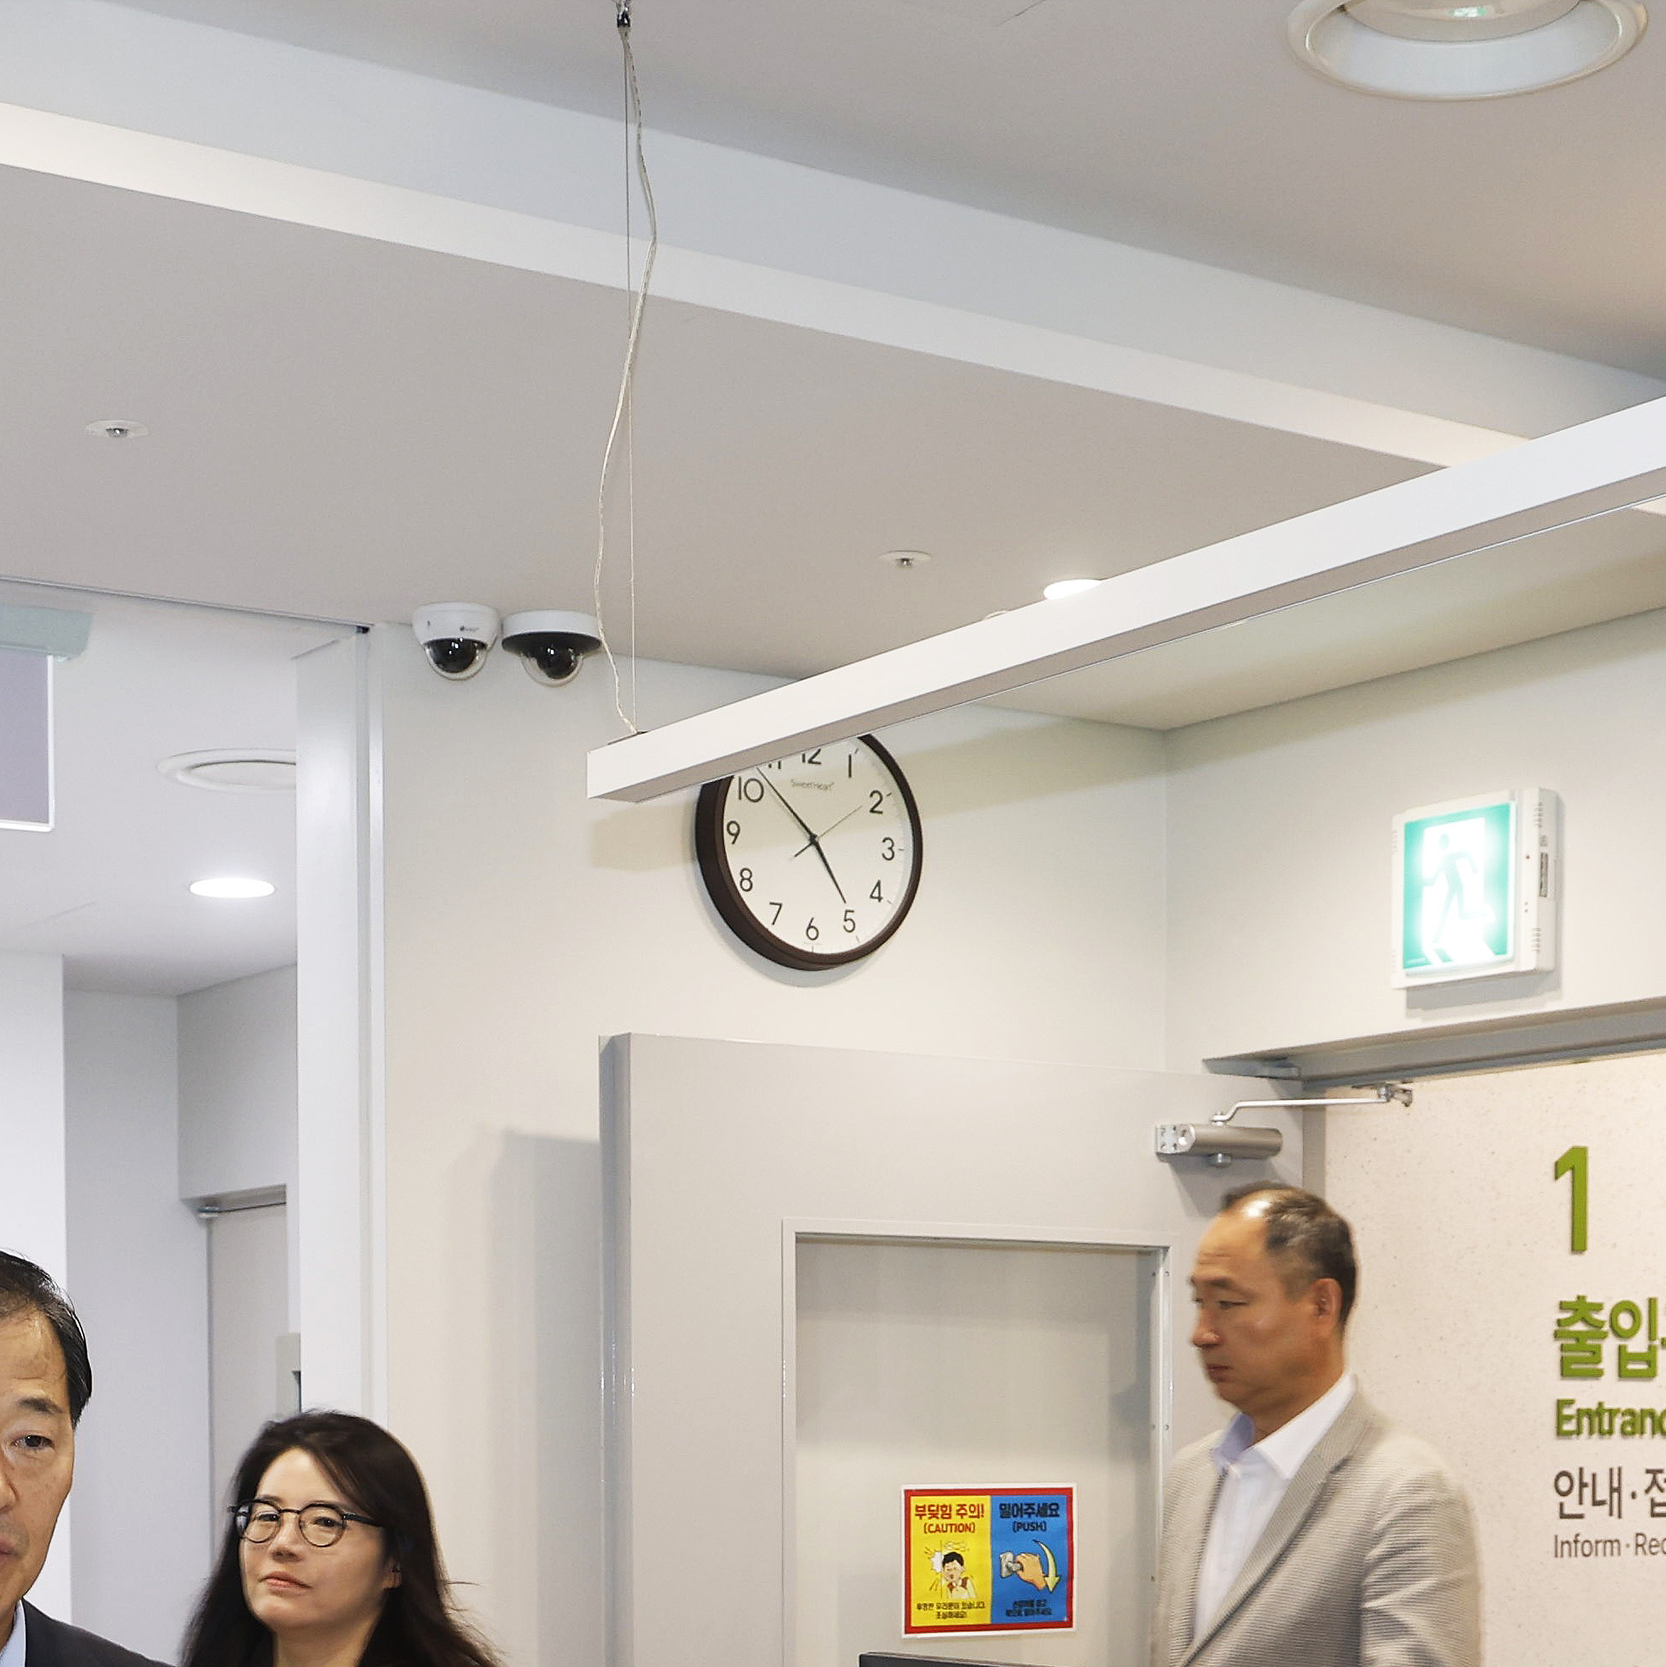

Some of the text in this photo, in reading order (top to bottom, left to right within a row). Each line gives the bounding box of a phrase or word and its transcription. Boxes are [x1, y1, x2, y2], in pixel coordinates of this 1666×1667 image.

[737, 777, 764, 803] 10
[869, 790, 884, 814] 2
[726, 820, 741, 845] 9
[881, 837, 895, 861] 3
[739, 868, 754, 892] 8
[869, 879, 884, 903] 4
[768, 902, 783, 926] 7
[843, 909, 856, 933] 5
[805, 917, 820, 941] 6
[1554, 1145, 1589, 1254] 1
[956, 1503, 985, 1519] 주의!
[999, 1502, 1060, 1519] 밀어주세요
